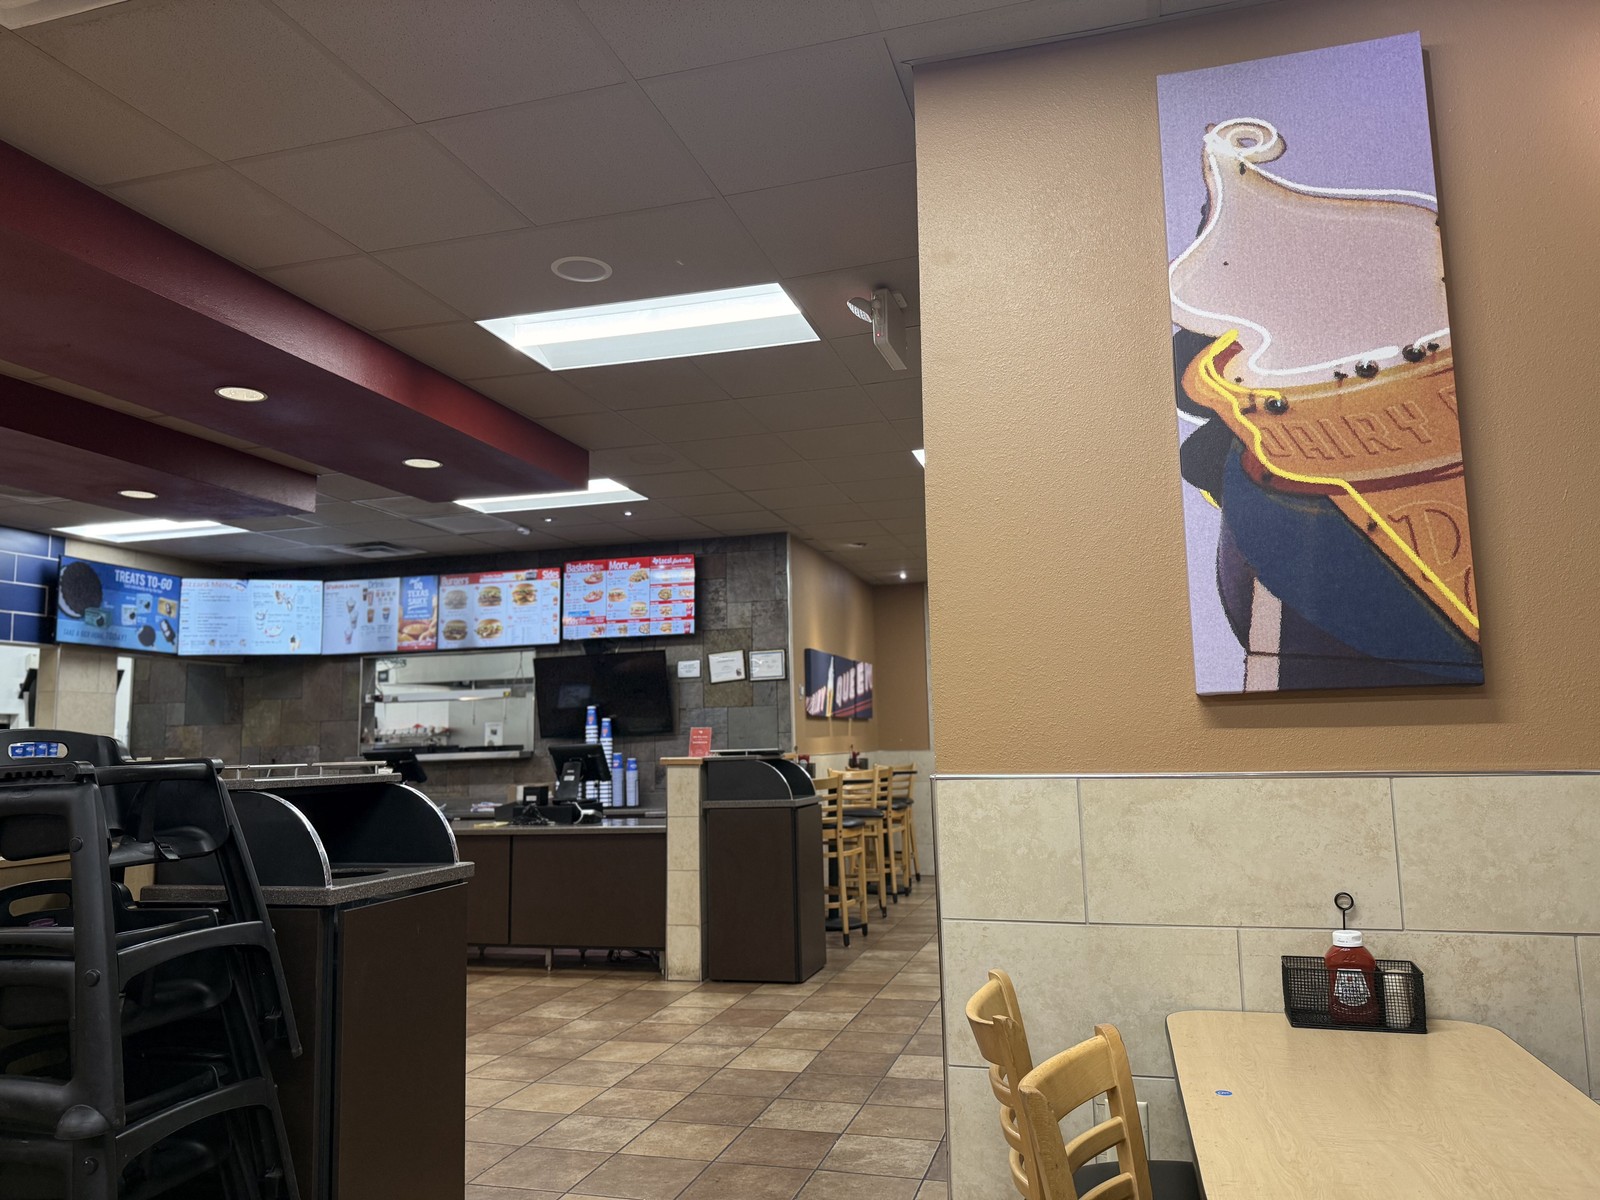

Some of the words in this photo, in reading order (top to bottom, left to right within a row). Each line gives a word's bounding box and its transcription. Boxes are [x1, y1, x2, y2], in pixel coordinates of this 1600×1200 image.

[566, 562, 594, 573] Baskets
[608, 560, 628, 570] More
[542, 570, 559, 579] Sides
[114, 569, 146, 587] TREATS
[147, 575, 173, 591] TO-GO
[441, 576, 469, 586] Burgers
[407, 589, 429, 598] TEXAS
[408, 597, 427, 606] SAUCE
[836, 662, 873, 708] QUEEN
